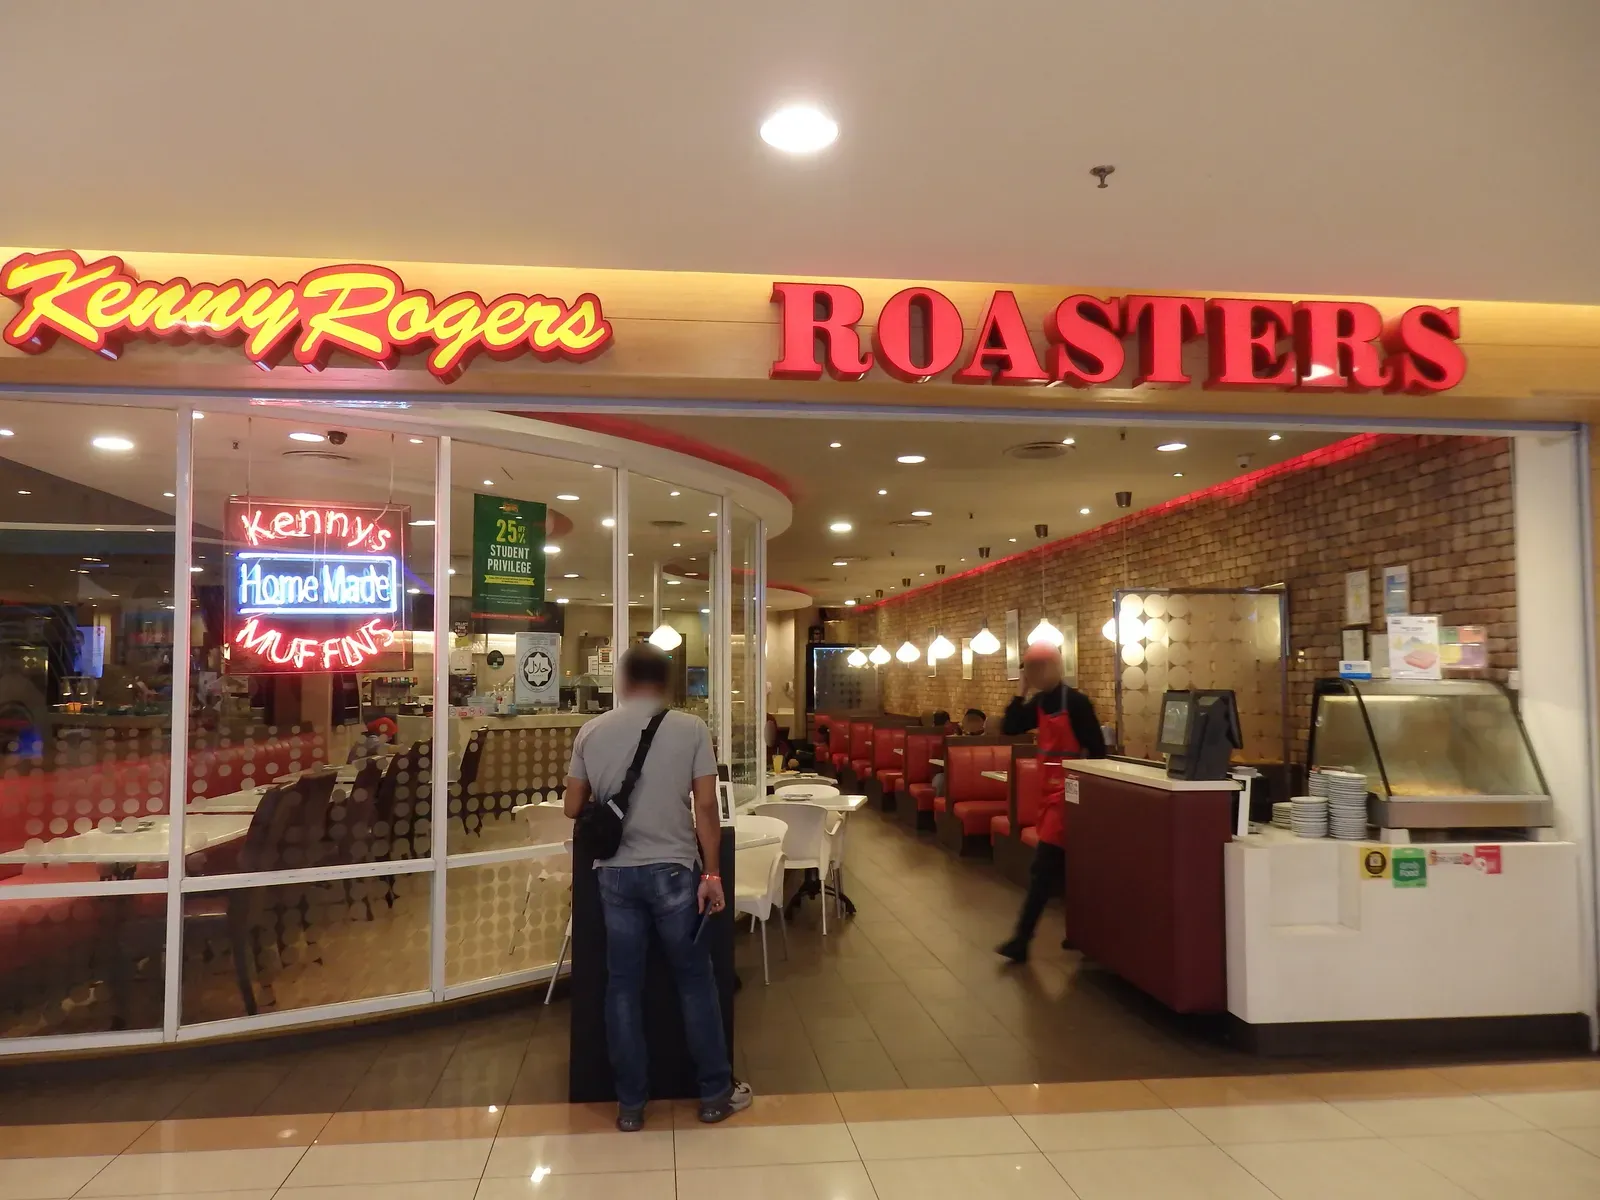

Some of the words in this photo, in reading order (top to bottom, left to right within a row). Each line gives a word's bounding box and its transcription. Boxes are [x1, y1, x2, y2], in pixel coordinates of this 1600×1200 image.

[6, 257, 300, 356] Kenny
[300, 270, 605, 370] Rogers
[770, 281, 1467, 391] ROASTERS
[487, 558, 532, 574] PRIVILEGE
[490, 544, 530, 560] STUDENT
[240, 563, 319, 605] Home
[322, 564, 391, 604] Made
[236, 618, 395, 668] MUFFINS
